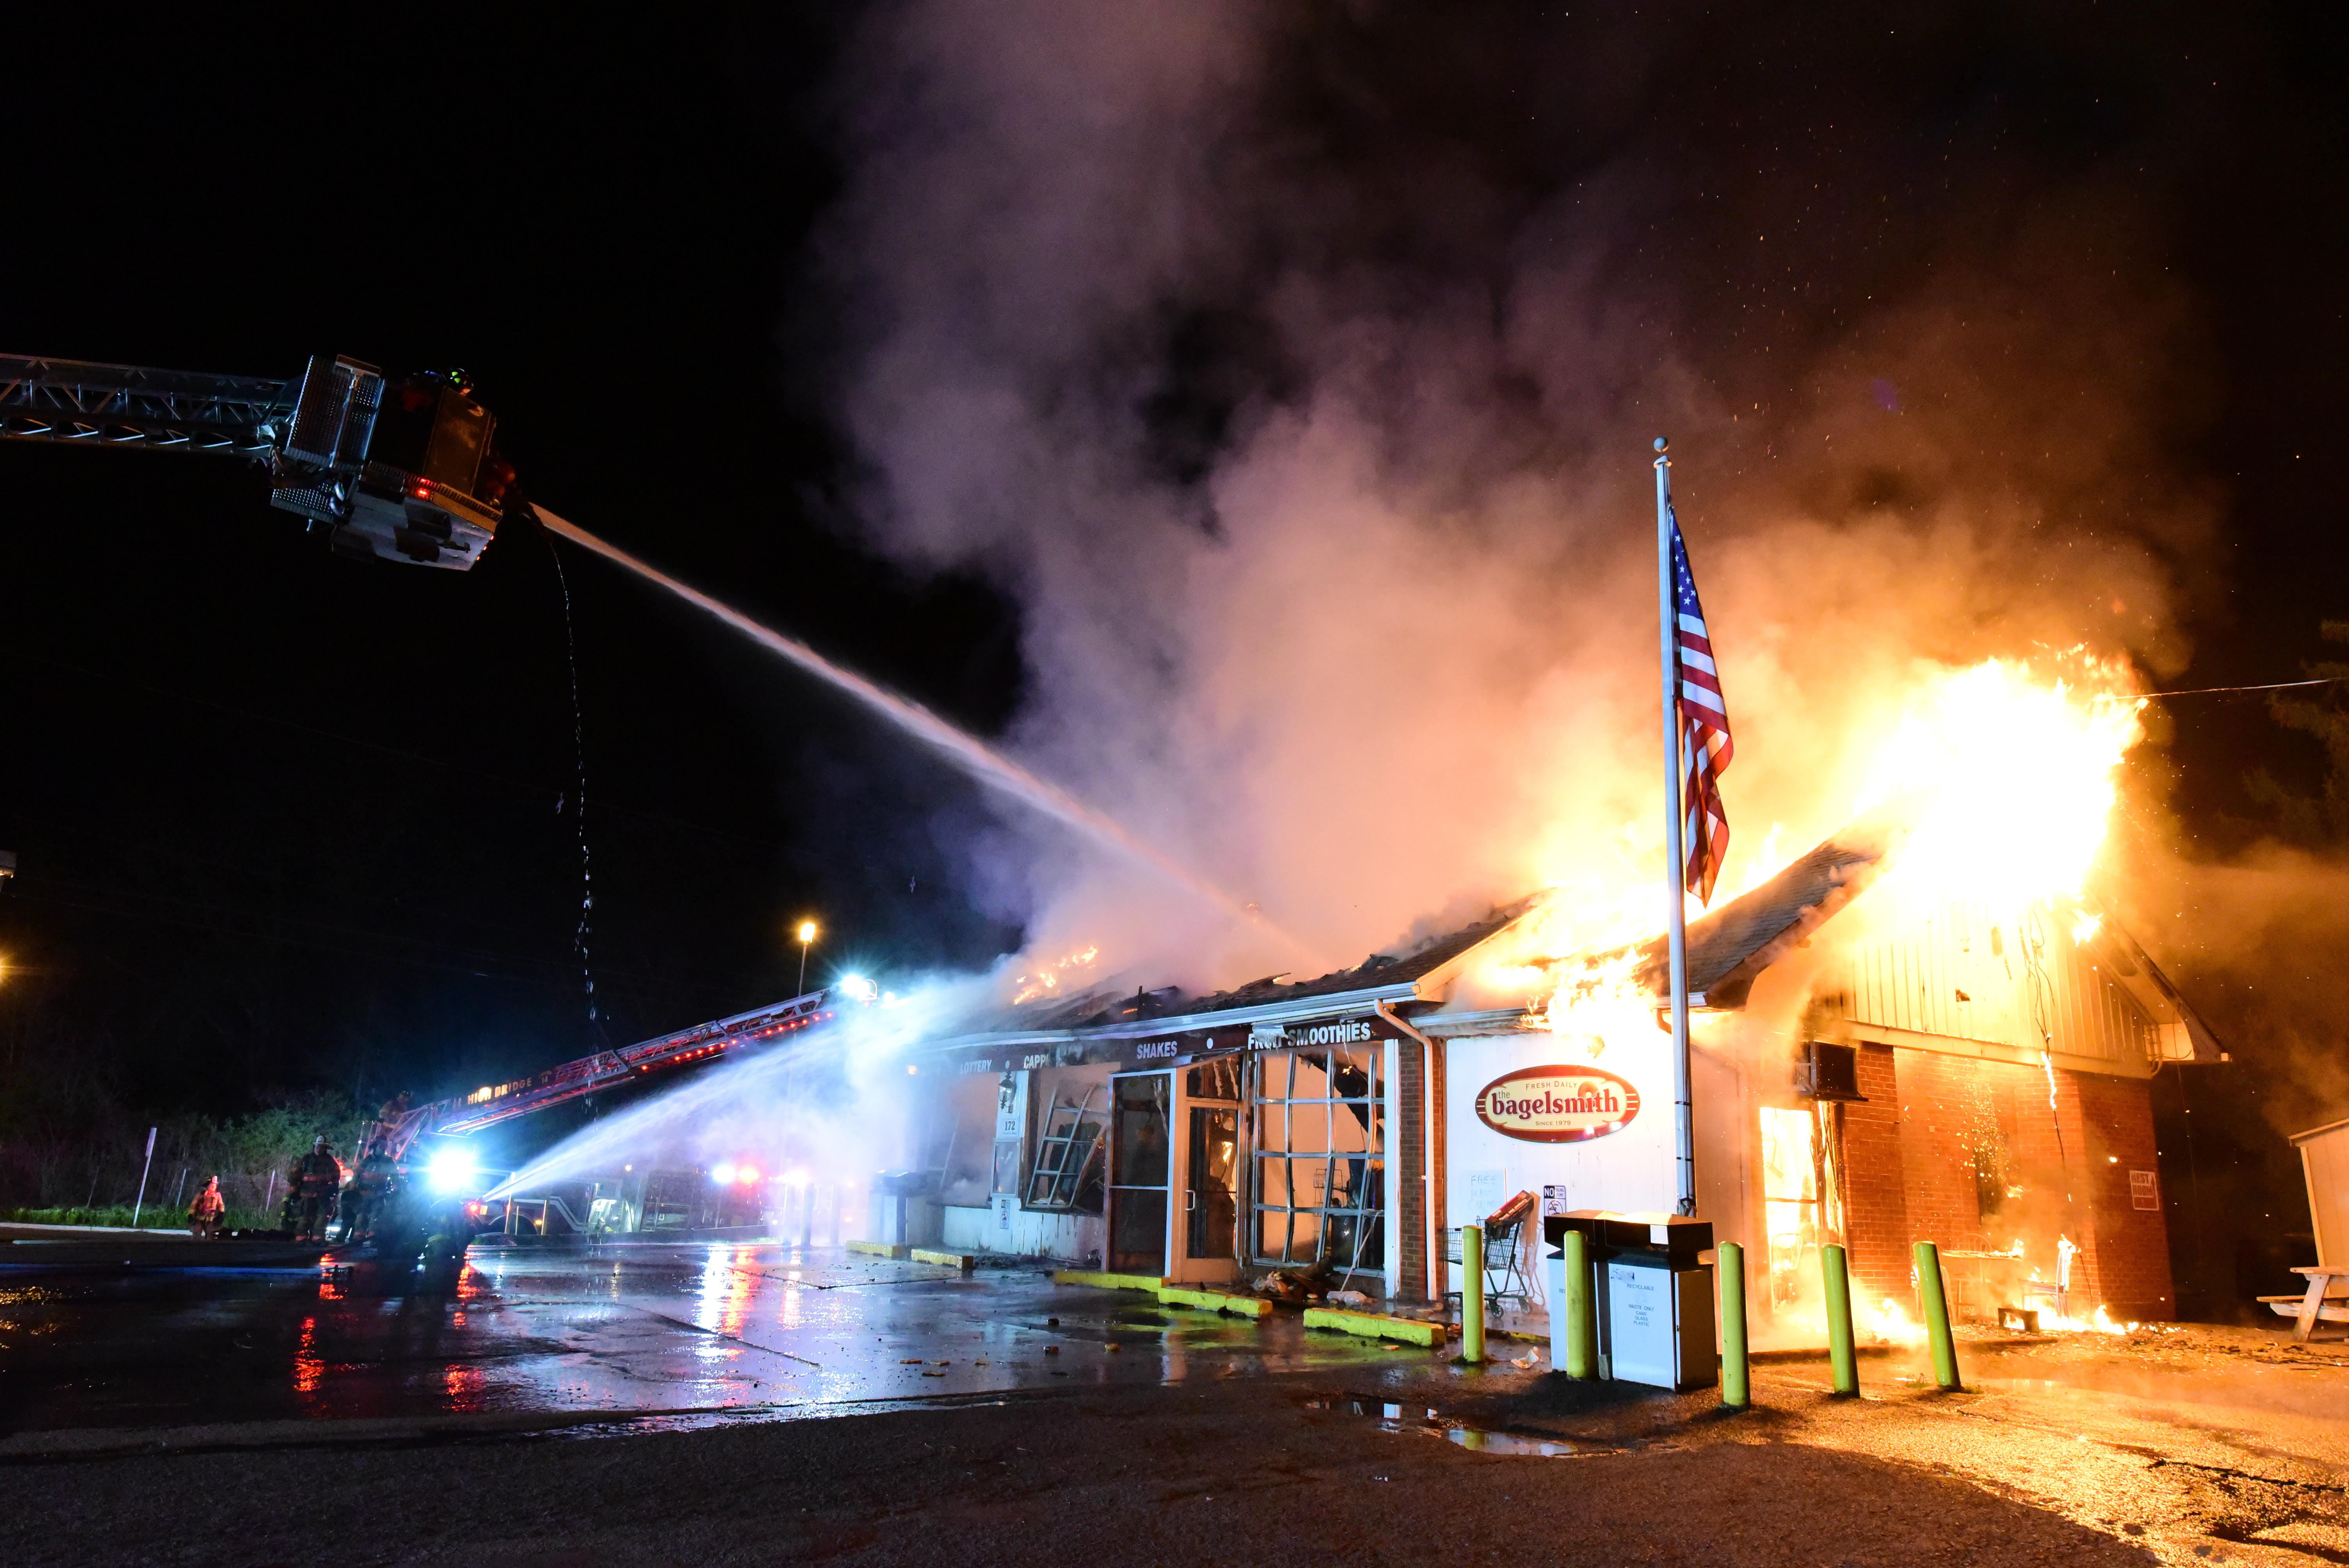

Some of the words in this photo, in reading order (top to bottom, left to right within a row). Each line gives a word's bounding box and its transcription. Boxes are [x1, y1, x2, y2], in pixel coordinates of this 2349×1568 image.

[1287, 1022, 1371, 1046] SMOOTHIES
[1137, 1041, 1177, 1059] SHAKES
[960, 1059, 992, 1074] LOTTERY
[494, 1077, 532, 1098] BRIDGE
[1498, 1090, 1510, 1099] the
[1491, 1088, 1619, 1120] bagelsmith
[1005, 1121, 1015, 1131] 172
[1544, 1187, 1554, 1197] NO
